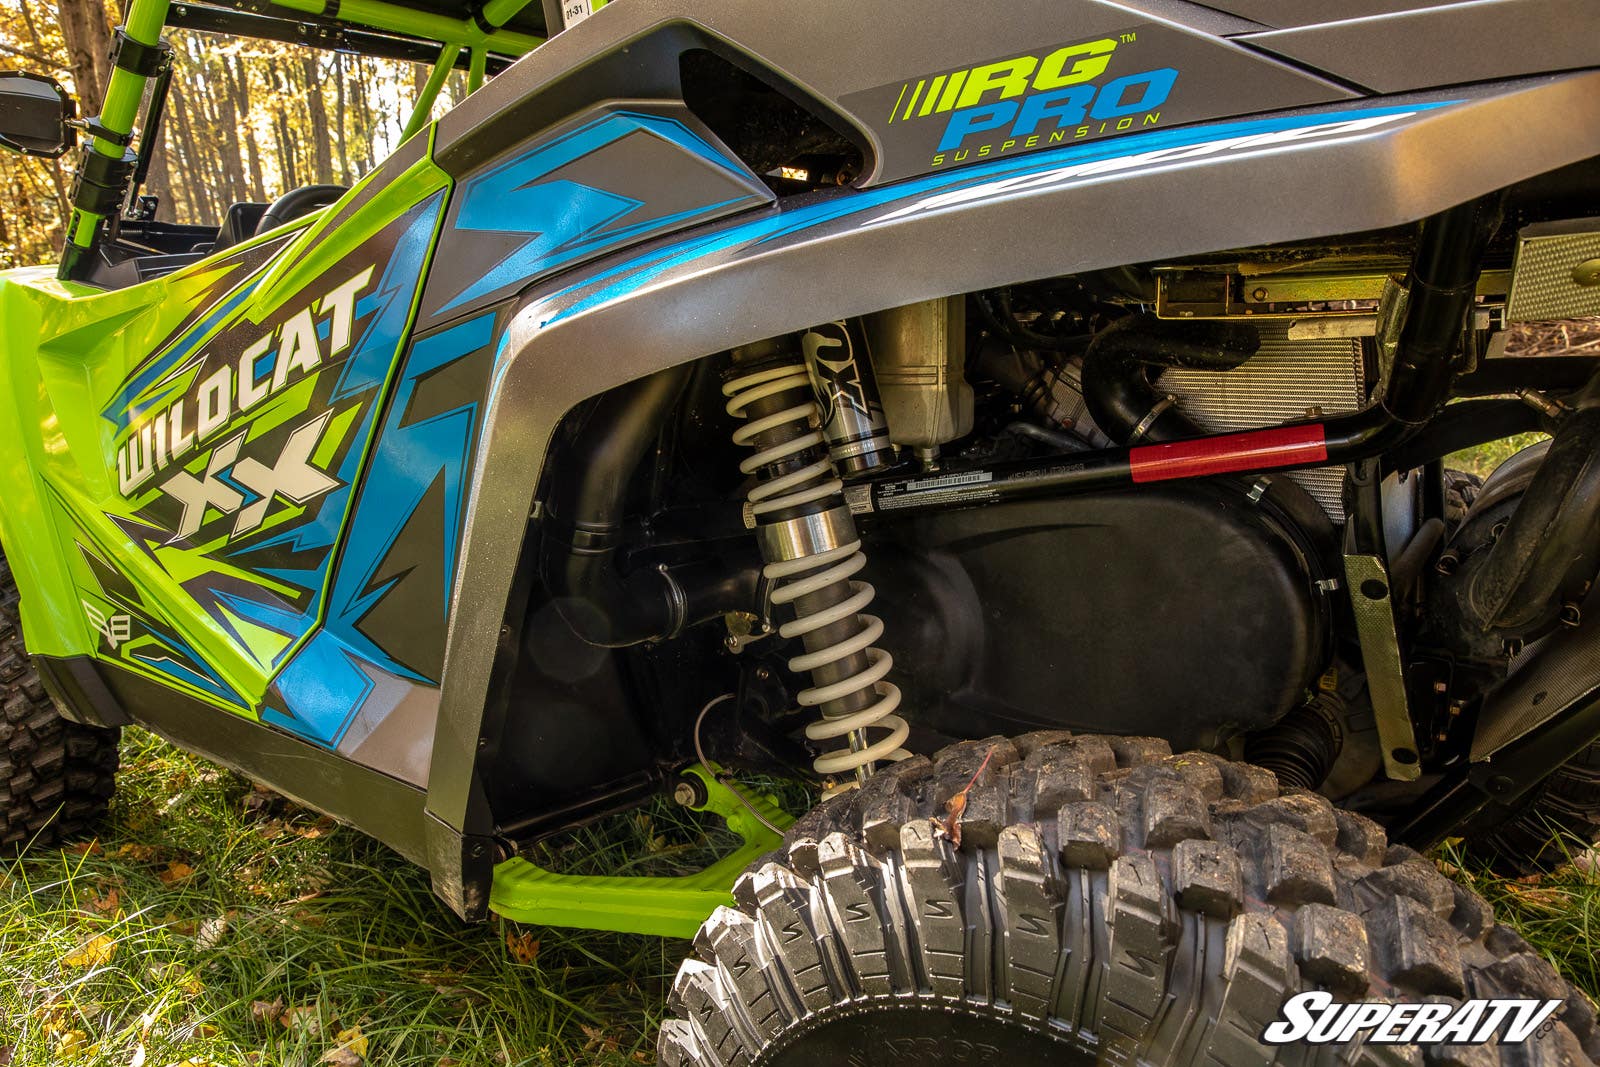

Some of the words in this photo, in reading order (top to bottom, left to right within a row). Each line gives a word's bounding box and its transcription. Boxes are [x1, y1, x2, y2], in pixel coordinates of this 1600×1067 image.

[931, 113, 1160, 166] SUSPENSION
[937, 67, 1179, 152] PRO
[117, 264, 375, 497] WILDCAT
[160, 408, 341, 544] XX
